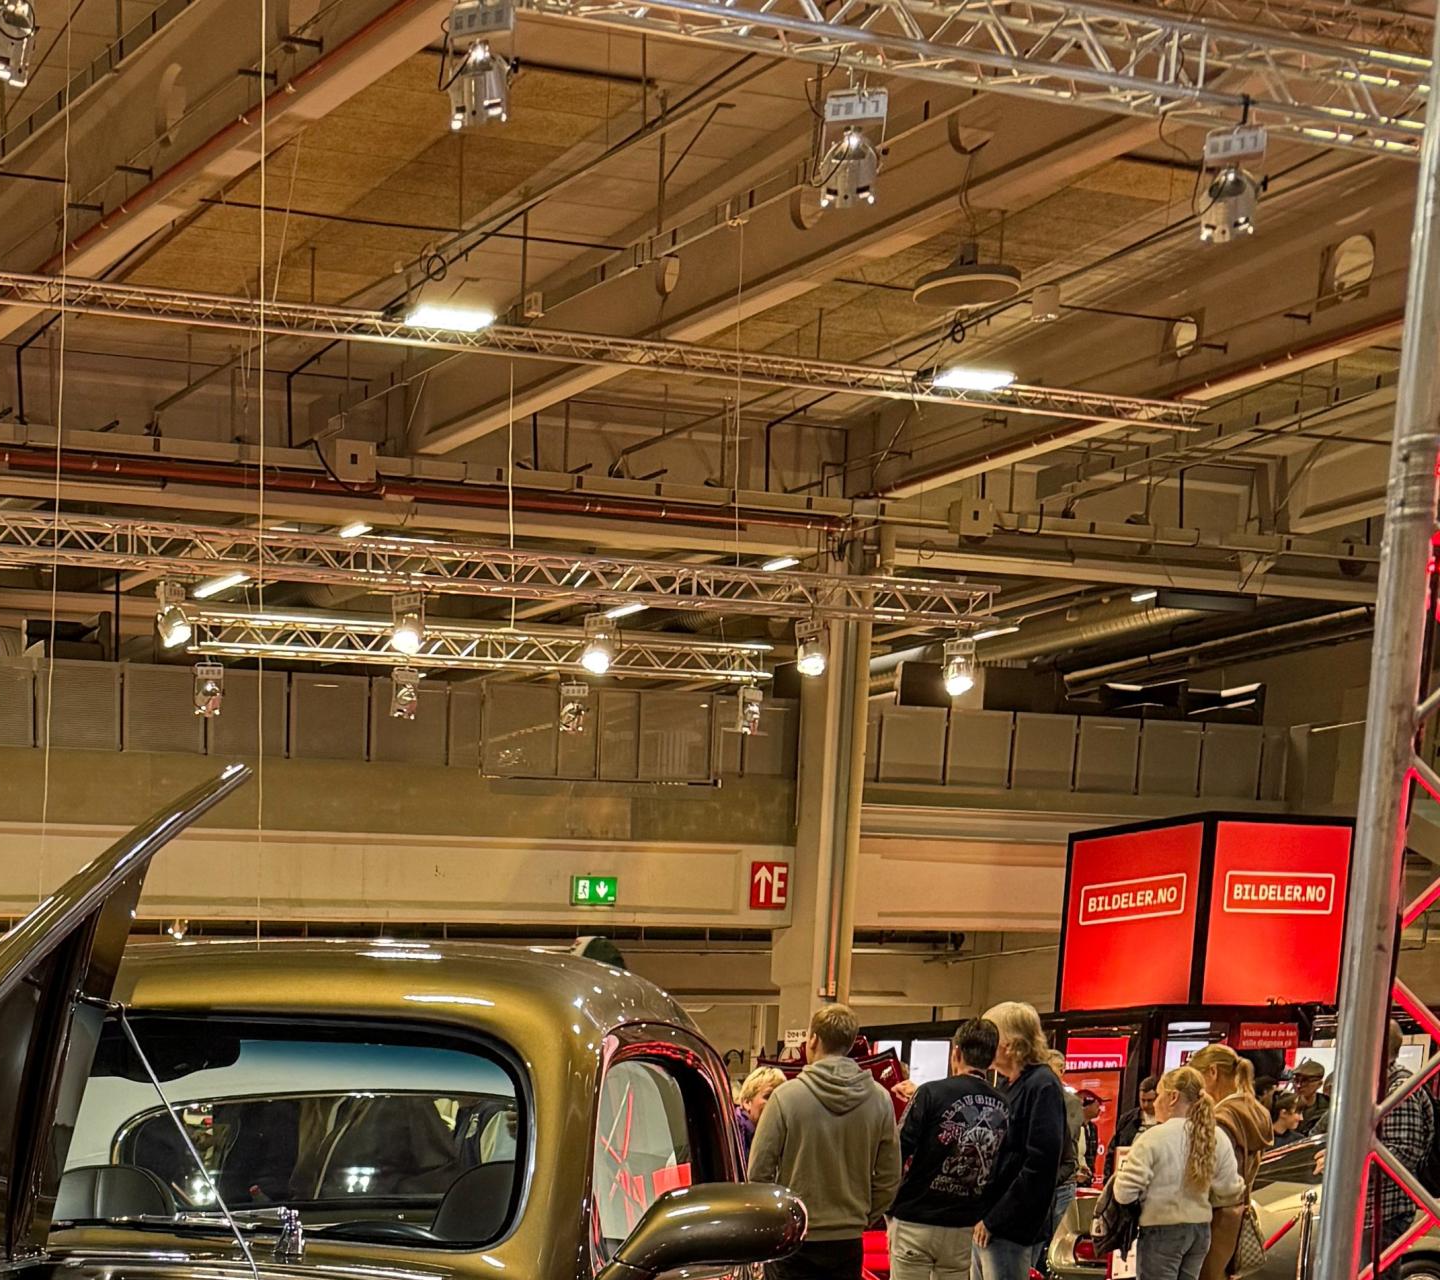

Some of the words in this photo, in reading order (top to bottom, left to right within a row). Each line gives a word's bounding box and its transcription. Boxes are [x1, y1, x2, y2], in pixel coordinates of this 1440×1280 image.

[771, 866, 787, 904] E
[1233, 883, 1326, 902] BILDELER.NO
[1087, 886, 1178, 913] BILDELER.NO
